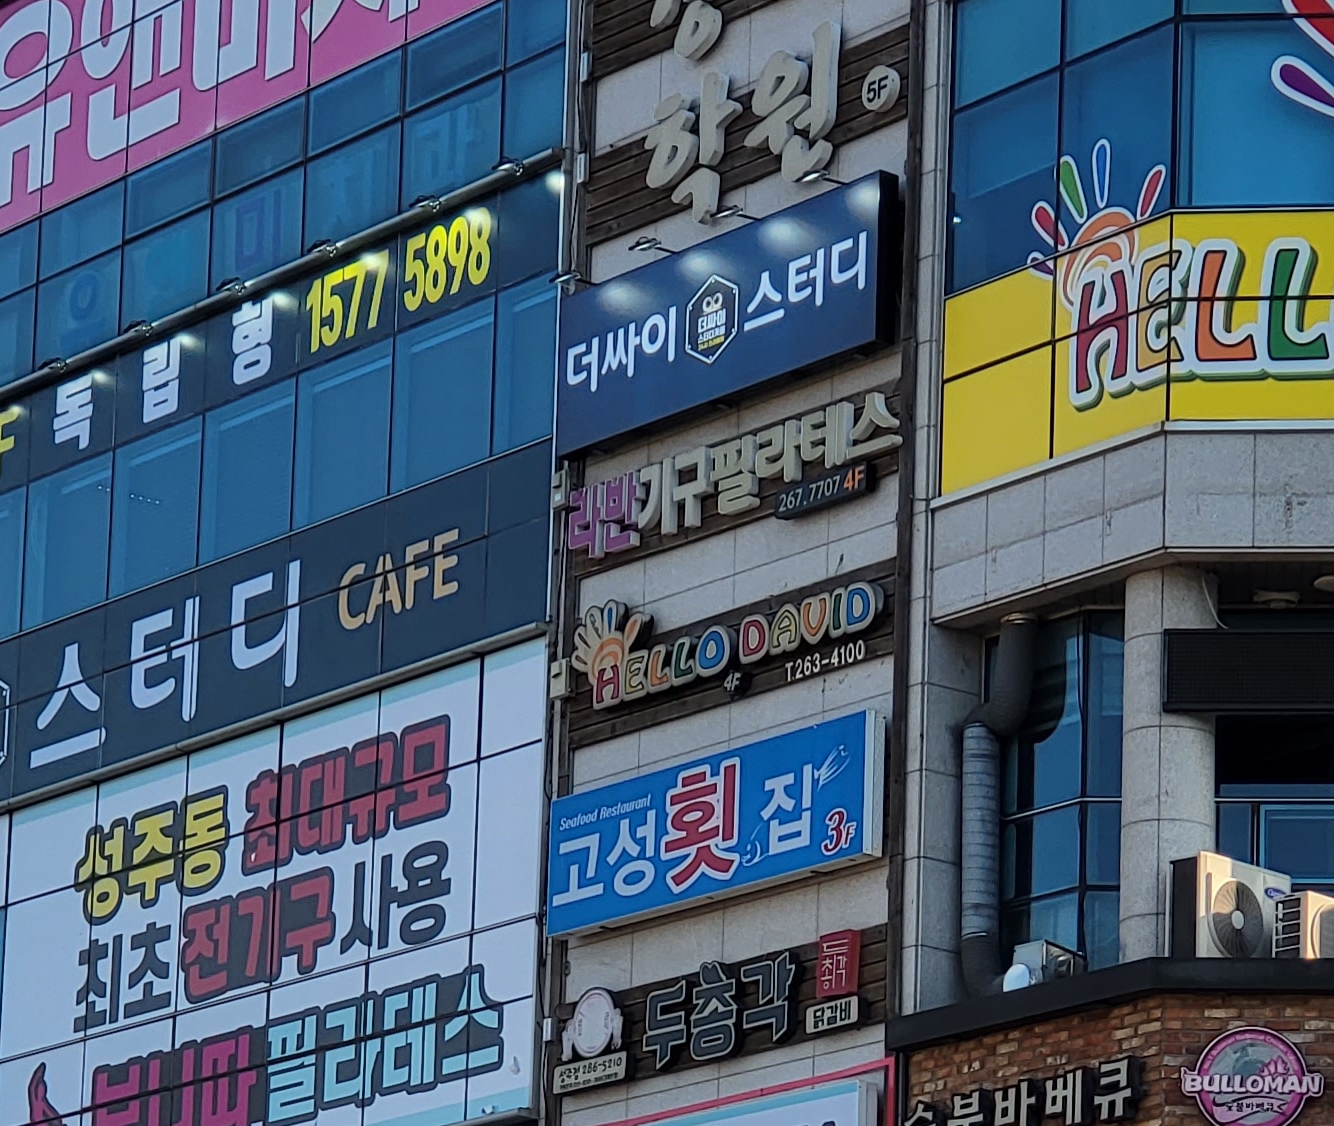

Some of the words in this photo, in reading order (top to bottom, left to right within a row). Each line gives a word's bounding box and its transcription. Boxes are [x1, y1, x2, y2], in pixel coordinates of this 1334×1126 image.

[645, 19, 841, 225] 학원
[867, 76, 889, 102] 5F
[307, 249, 390, 353] 1577
[403, 207, 492, 312] 5898
[567, 306, 678, 393] 더싸이
[744, 229, 868, 332] 스터디
[637, 391, 904, 537] 기구필라테스
[778, 475, 841, 512] 267.7707
[843, 465, 866, 491] 4F
[338, 525, 460, 635] CAFE
[30, 556, 299, 771] 스터디
[593, 625, 737, 710] HELLO
[738, 581, 884, 665] DAVID
[723, 672, 741, 694] 4F
[785, 639, 866, 684] T.263-4100
[75, 784, 229, 925] 성주동
[243, 714, 451, 876] 최대규모
[552, 756, 813, 908] 고성횟집
[820, 808, 857, 857] 3F
[559, 808, 598, 831] Seafood
[599, 794, 652, 822] Restaurant
[73, 922, 173, 1034] 최초
[642, 950, 797, 1072] 두총각
[812, 1001, 852, 1030] 닭갈비
[581, 1055, 623, 1077] 286-5210
[1184, 1070, 1324, 1102] BULLOMAN
